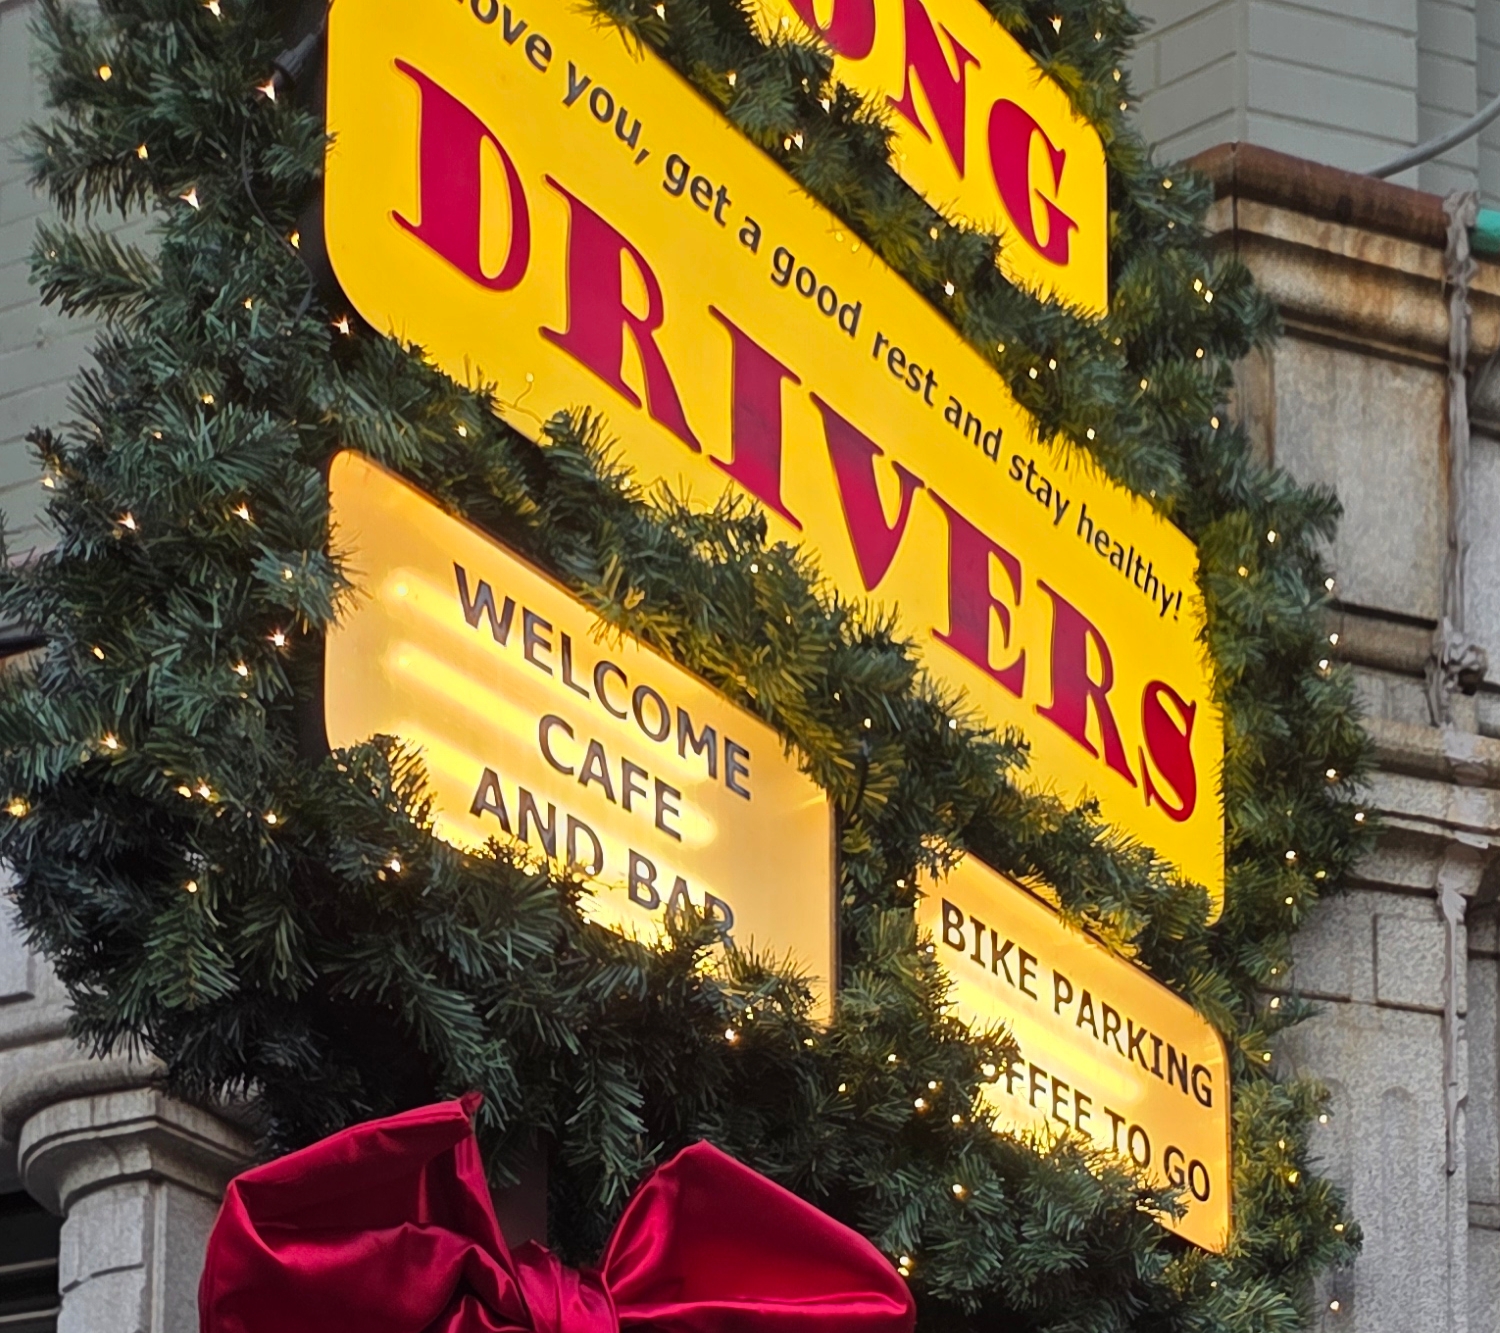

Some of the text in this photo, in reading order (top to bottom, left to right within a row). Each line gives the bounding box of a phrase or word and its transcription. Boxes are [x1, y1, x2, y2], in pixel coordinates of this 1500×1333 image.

[470, 0, 1184, 621] ove you, get a good rest and stay healthy!
[392, 57, 1198, 823] DRIVERS
[453, 561, 751, 801] WELCOME
[538, 713, 682, 842] CAFE
[469, 767, 604, 877] AND
[941, 897, 1212, 1108] BIKE PARKING
[1004, 1056, 1210, 1202] FFEE TO GO
